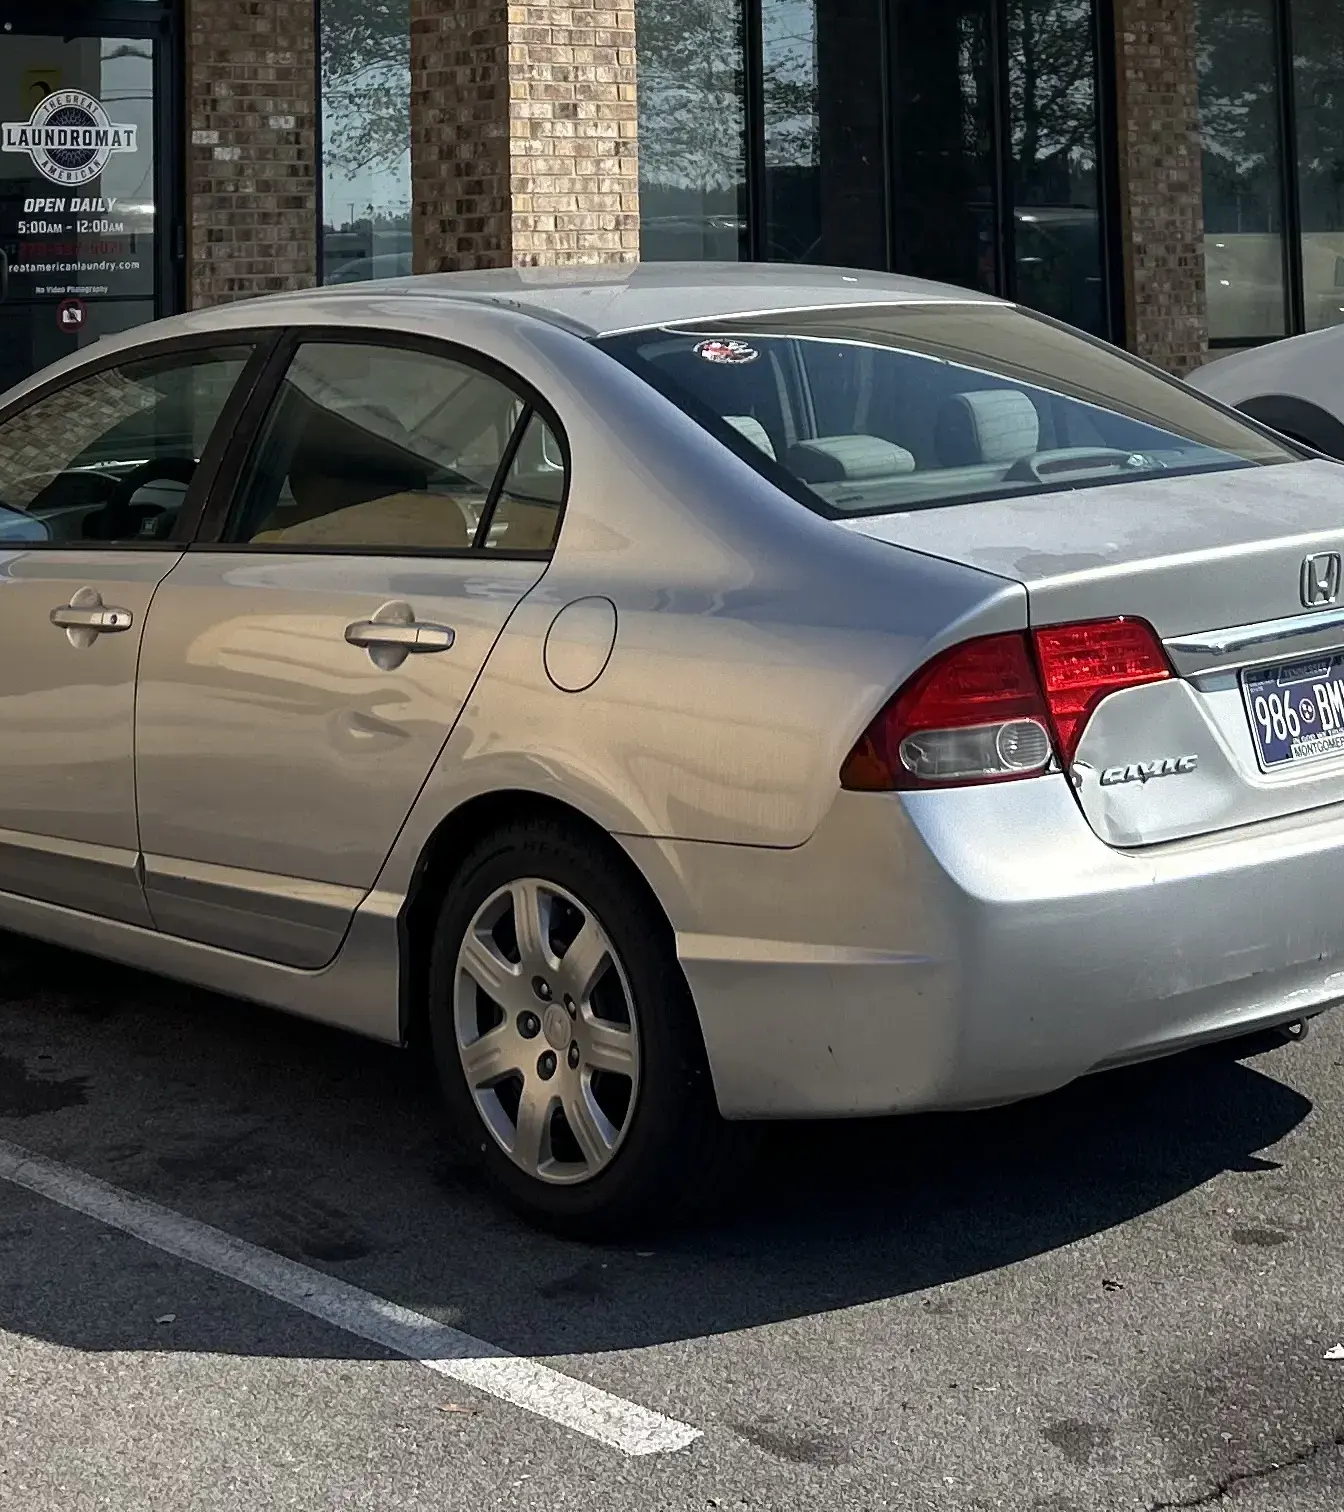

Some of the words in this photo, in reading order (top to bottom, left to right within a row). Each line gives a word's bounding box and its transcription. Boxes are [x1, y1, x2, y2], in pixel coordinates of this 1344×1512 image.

[43, 98, 62, 113] THE
[65, 94, 99, 113] GREAT
[7, 128, 134, 147] LAUNDROMAT
[41, 160, 101, 181] AMERICAN
[23, 198, 66, 213] OPEN
[70, 197, 117, 213] DAILY
[18, 220, 63, 234] 5:00AM
[76, 219, 124, 233] 12:00AM
[8, 260, 140, 273] reatamericanlaundry.com
[1254, 689, 1301, 745] 986
[1099, 754, 1198, 786] CIVIC
